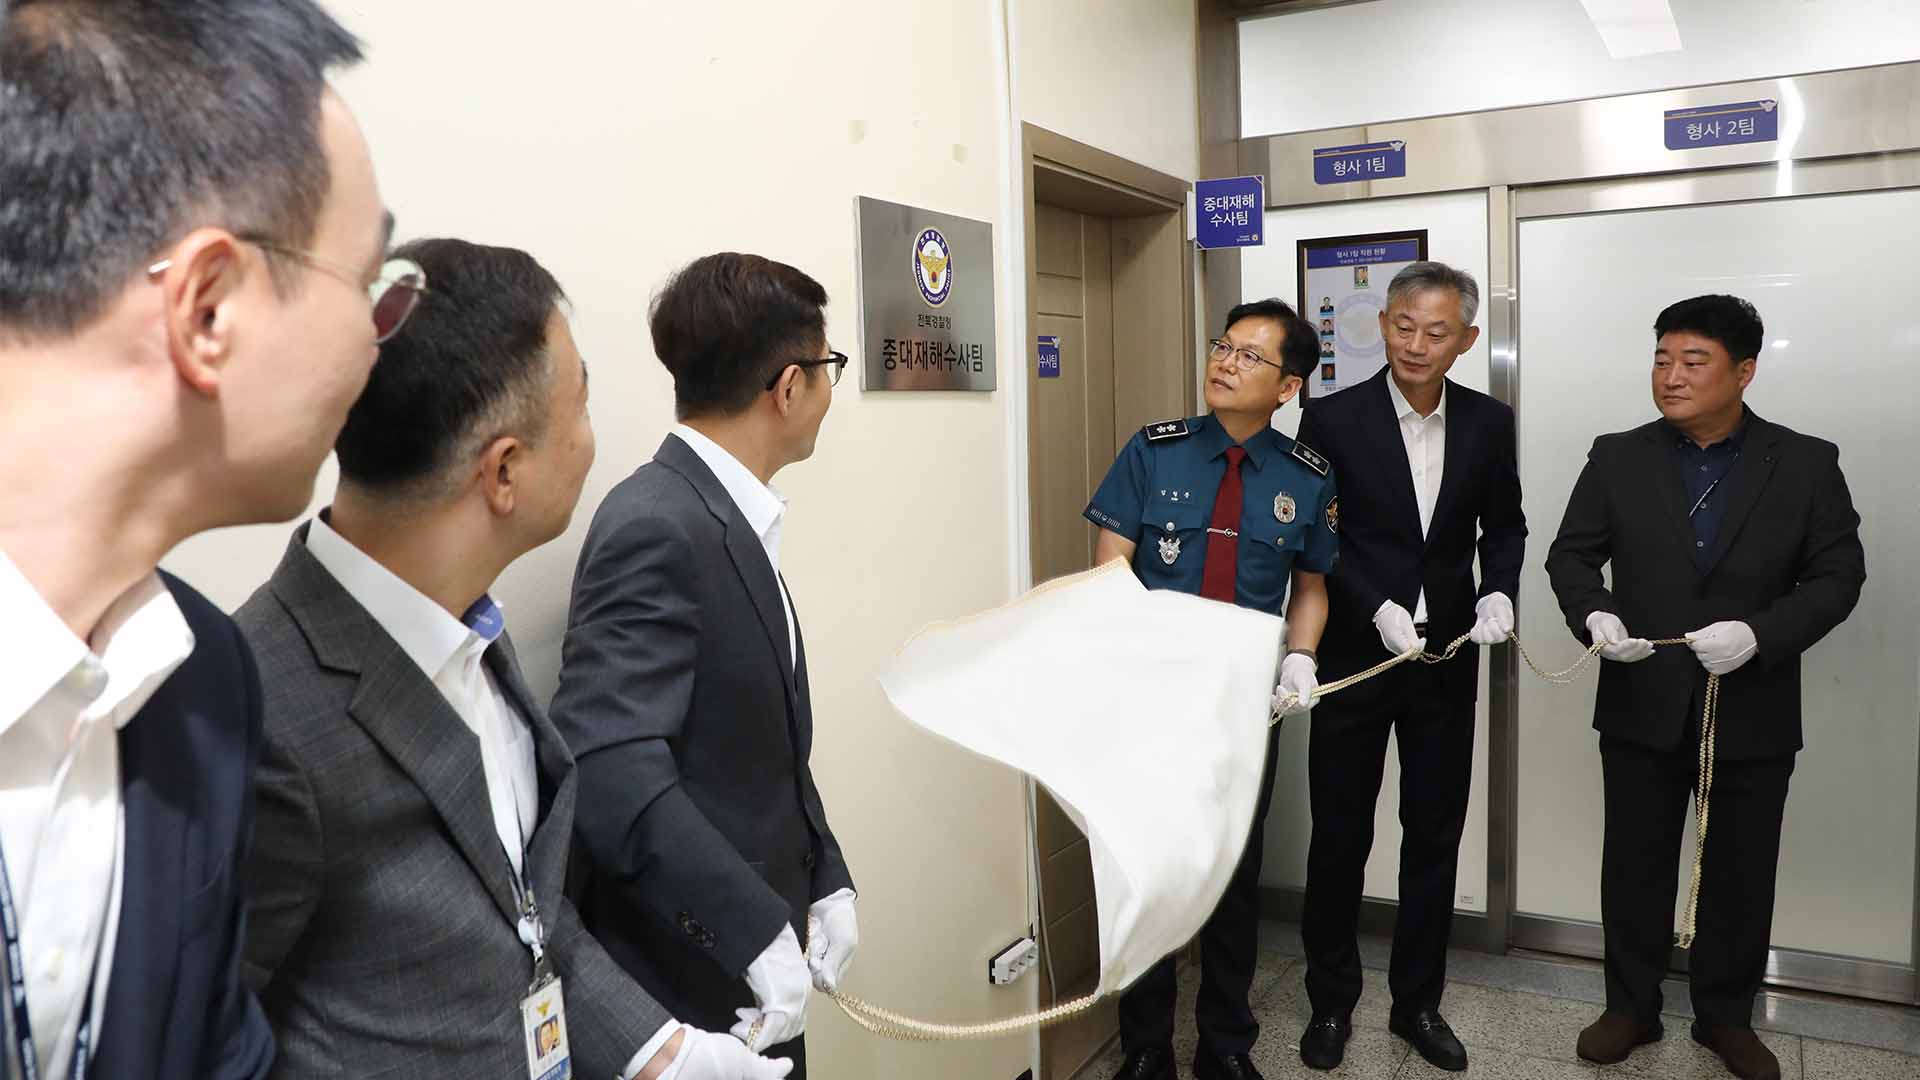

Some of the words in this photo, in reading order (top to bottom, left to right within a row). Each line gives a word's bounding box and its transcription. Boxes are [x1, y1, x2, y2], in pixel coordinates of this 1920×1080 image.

[1686, 121, 1720, 141] 형사
[1727, 117, 1754, 135] 2팀
[1333, 160, 1361, 176] 형사
[1366, 156, 1385, 172] 1팀
[1204, 193, 1254, 212] 중대재해
[1210, 210, 1248, 227] 수사팀
[882, 339, 983, 373] 중대재해수사팀
